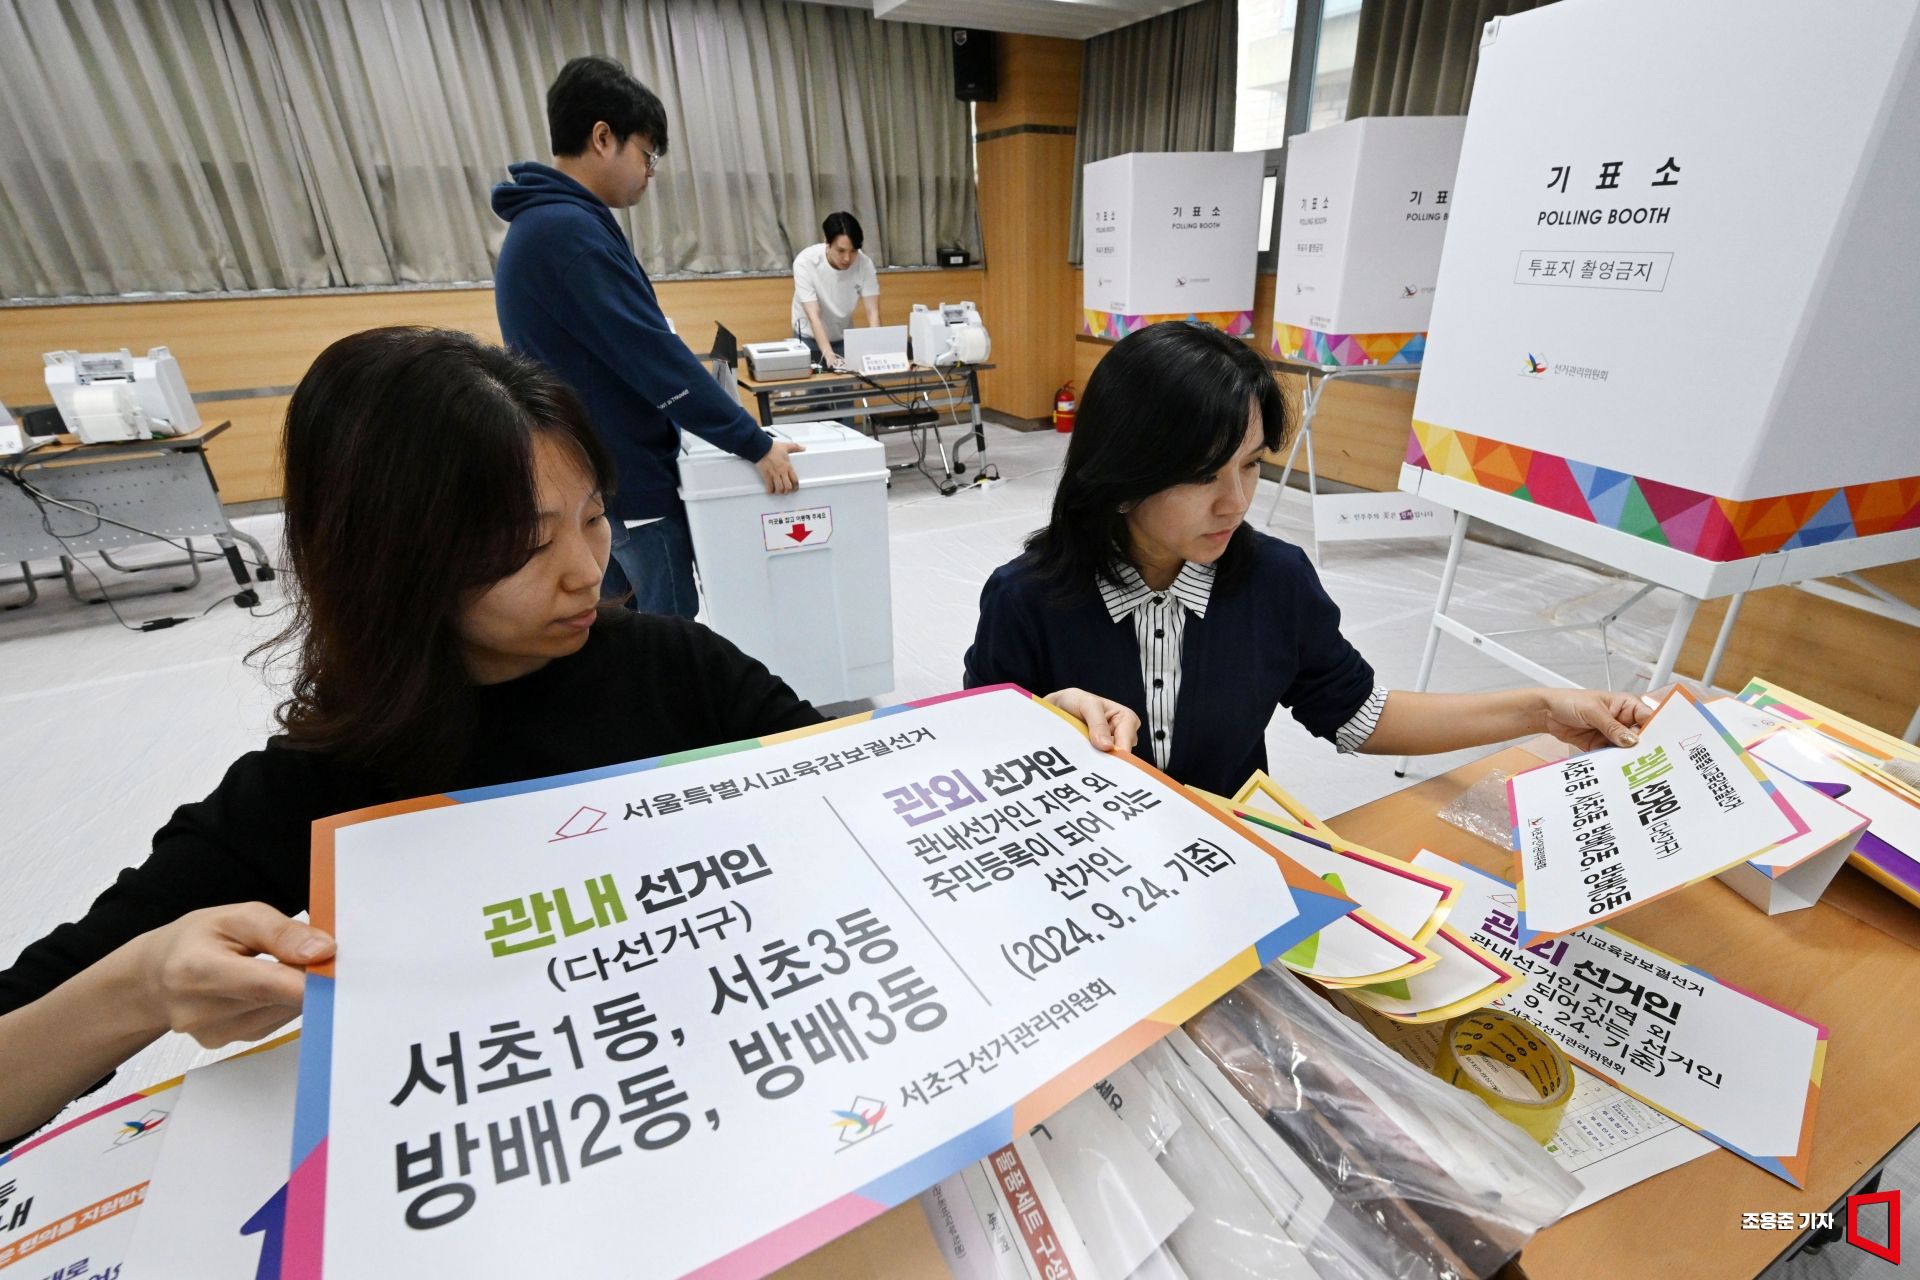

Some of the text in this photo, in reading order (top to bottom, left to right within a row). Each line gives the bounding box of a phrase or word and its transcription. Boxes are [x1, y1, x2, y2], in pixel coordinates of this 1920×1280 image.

[1406, 213, 1440, 221] POLLING
[1537, 207, 1671, 226] POLLING BOOTH
[1528, 259, 1654, 282] 투표지 촬영금지
[622, 727, 937, 822] 서울특별시교육감보궐선거
[882, 746, 1078, 828] 관외 선거인
[906, 773, 1117, 866] 관내선거인 지역 외
[1621, 745, 1682, 860] 관내 선거인 (다선거구)
[1689, 744, 1744, 813] 서울특별시교육감보궐선거
[923, 787, 1162, 902] 주민등록이 되어 있는
[1044, 847, 1132, 901] 선거인
[1583, 862, 1632, 915] 방배3동
[482, 843, 773, 958] 관내 선거인
[546, 900, 753, 992] (다선거구)
[1001, 837, 1236, 981] (2024. 9. 24. 기준)
[390, 907, 899, 1108] 서초1동, 서초3동
[1469, 931, 1671, 1044] 관내선거인 지역 외
[1569, 930, 1704, 997] 시교육감보궐선거
[1572, 959, 1682, 1026] 선거인
[899, 977, 1117, 1108] 서초구선거관리위원회
[1509, 1007, 1625, 1076] 서초구선거관리위원회
[1532, 981, 1723, 1089] 되어있는 선거인
[1604, 1036, 1665, 1077] 기준)
[395, 965, 948, 1231] 방배2동, 방배3동
